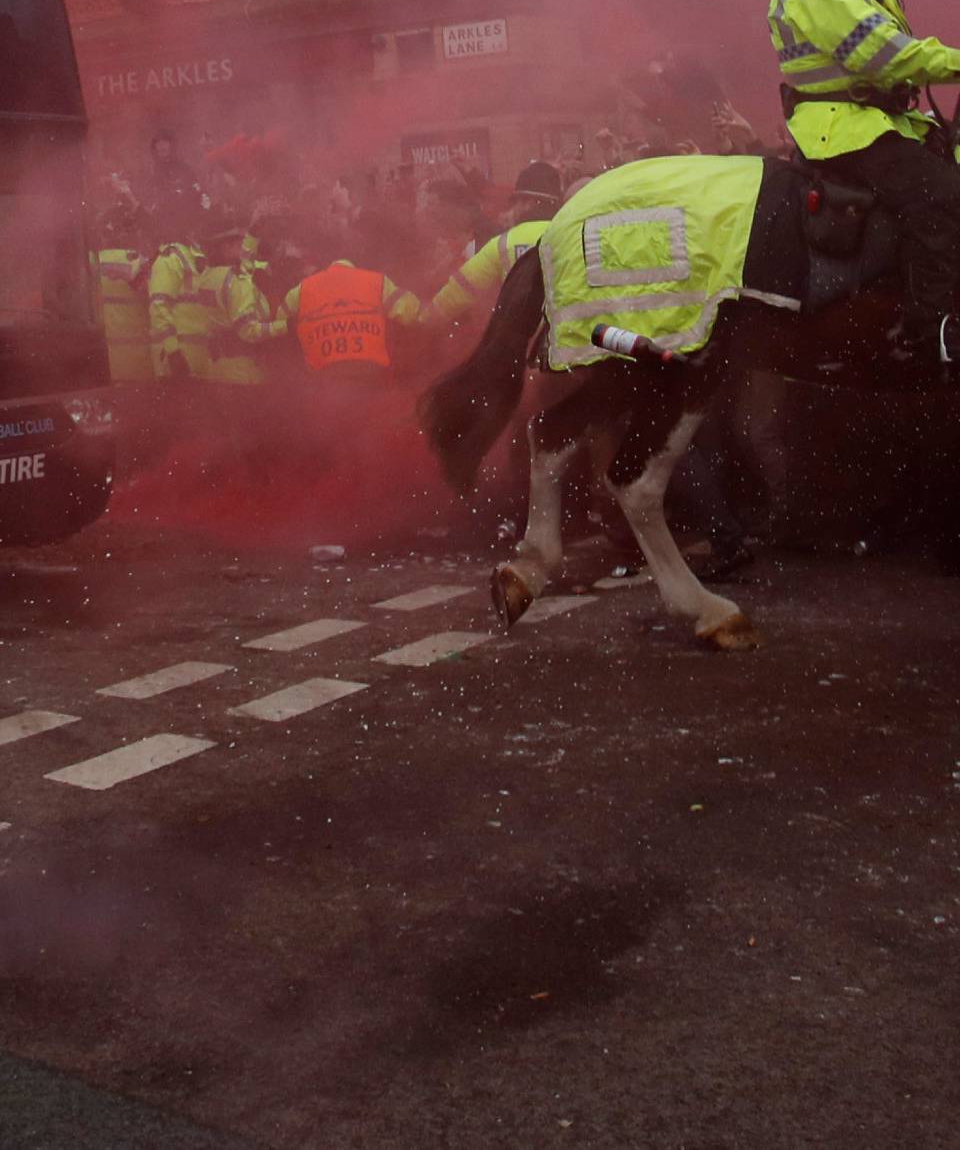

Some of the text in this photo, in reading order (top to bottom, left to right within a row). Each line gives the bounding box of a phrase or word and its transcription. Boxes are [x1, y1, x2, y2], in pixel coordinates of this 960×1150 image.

[448, 24, 502, 41] ARKLES
[448, 41, 484, 55] LANE
[94, 59, 233, 97] THE ARKLES
[306, 320, 381, 345] STEWARD
[25, 418, 54, 434] CLUB
